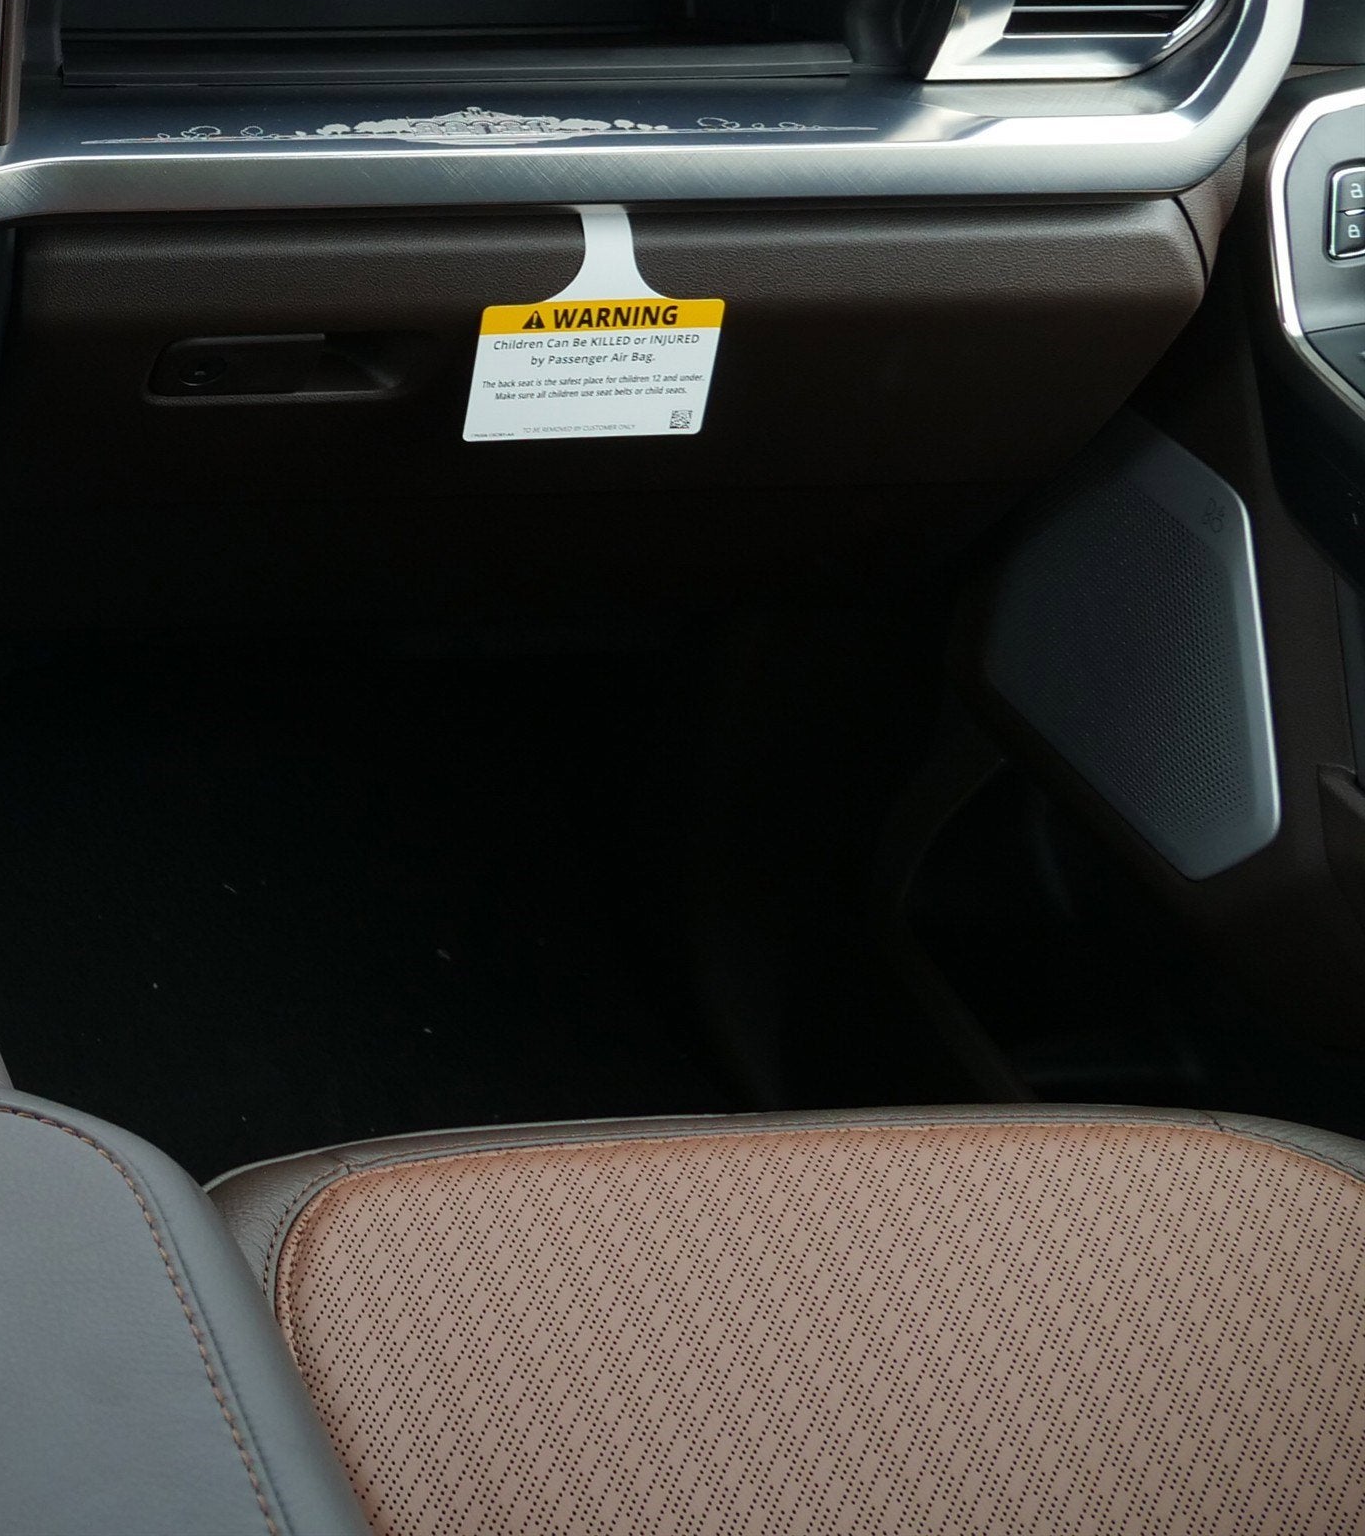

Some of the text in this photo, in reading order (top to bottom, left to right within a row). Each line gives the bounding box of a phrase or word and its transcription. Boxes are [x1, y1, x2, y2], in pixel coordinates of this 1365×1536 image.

[553, 305, 679, 329] WARNING
[493, 334, 700, 350] Children Can Be KILLED or INJURED
[531, 352, 656, 368] by Passenger Air Bag.
[483, 380, 496, 388] The
[497, 380, 515, 388] back
[517, 380, 534, 388] seat
[544, 378, 557, 386] the
[559, 377, 582, 386] safest
[583, 376, 603, 386] place
[605, 376, 617, 384] for
[619, 374, 649, 384] children
[652, 374, 661, 382] 12
[663, 374, 678, 382] and
[679, 374, 705, 382] under.
[494, 392, 516, 400] Make
[517, 392, 535, 400] sure
[536, 390, 547, 398] all
[547, 390, 579, 398] children
[595, 388, 613, 396] seat
[614, 388, 633, 396] belts
[645, 386, 663, 395] child
[665, 386, 688, 394] seats.
